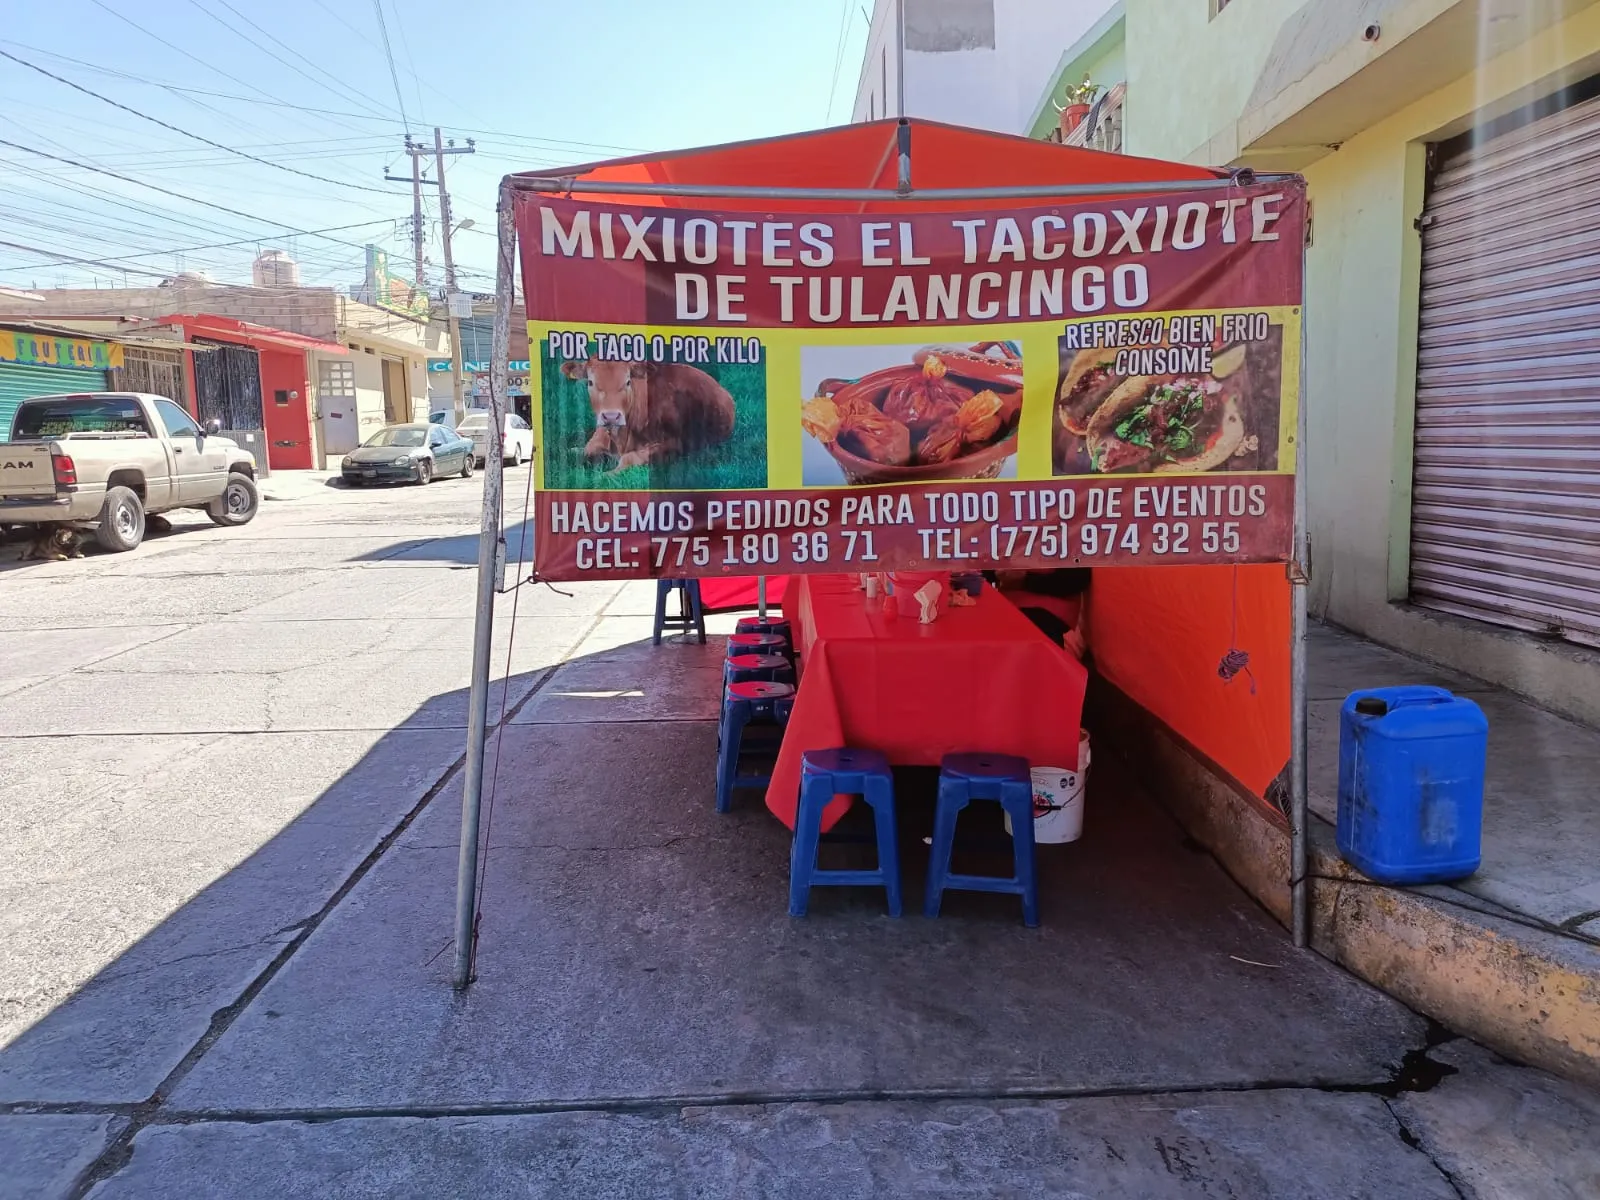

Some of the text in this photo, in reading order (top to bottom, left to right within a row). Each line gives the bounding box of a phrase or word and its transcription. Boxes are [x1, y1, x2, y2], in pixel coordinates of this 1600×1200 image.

[539, 193, 1284, 268] MIXIOTES EL TACOXIOTE
[674, 263, 1149, 323] DE TULANCINGO
[548, 331, 760, 364] POR TACO O POR KILO
[1065, 314, 1268, 349] REFRESCO BIEN FRIO
[1114, 342, 1213, 376] CONSOMÉ
[0, 460, 34, 469] AM
[552, 484, 1266, 534] HACEMOS PEDIDOS PARA TODO TIPO DE EVENTOS
[576, 521, 1240, 570] CEL: 775 180 36 71 TEL: (775) 974 32 55
